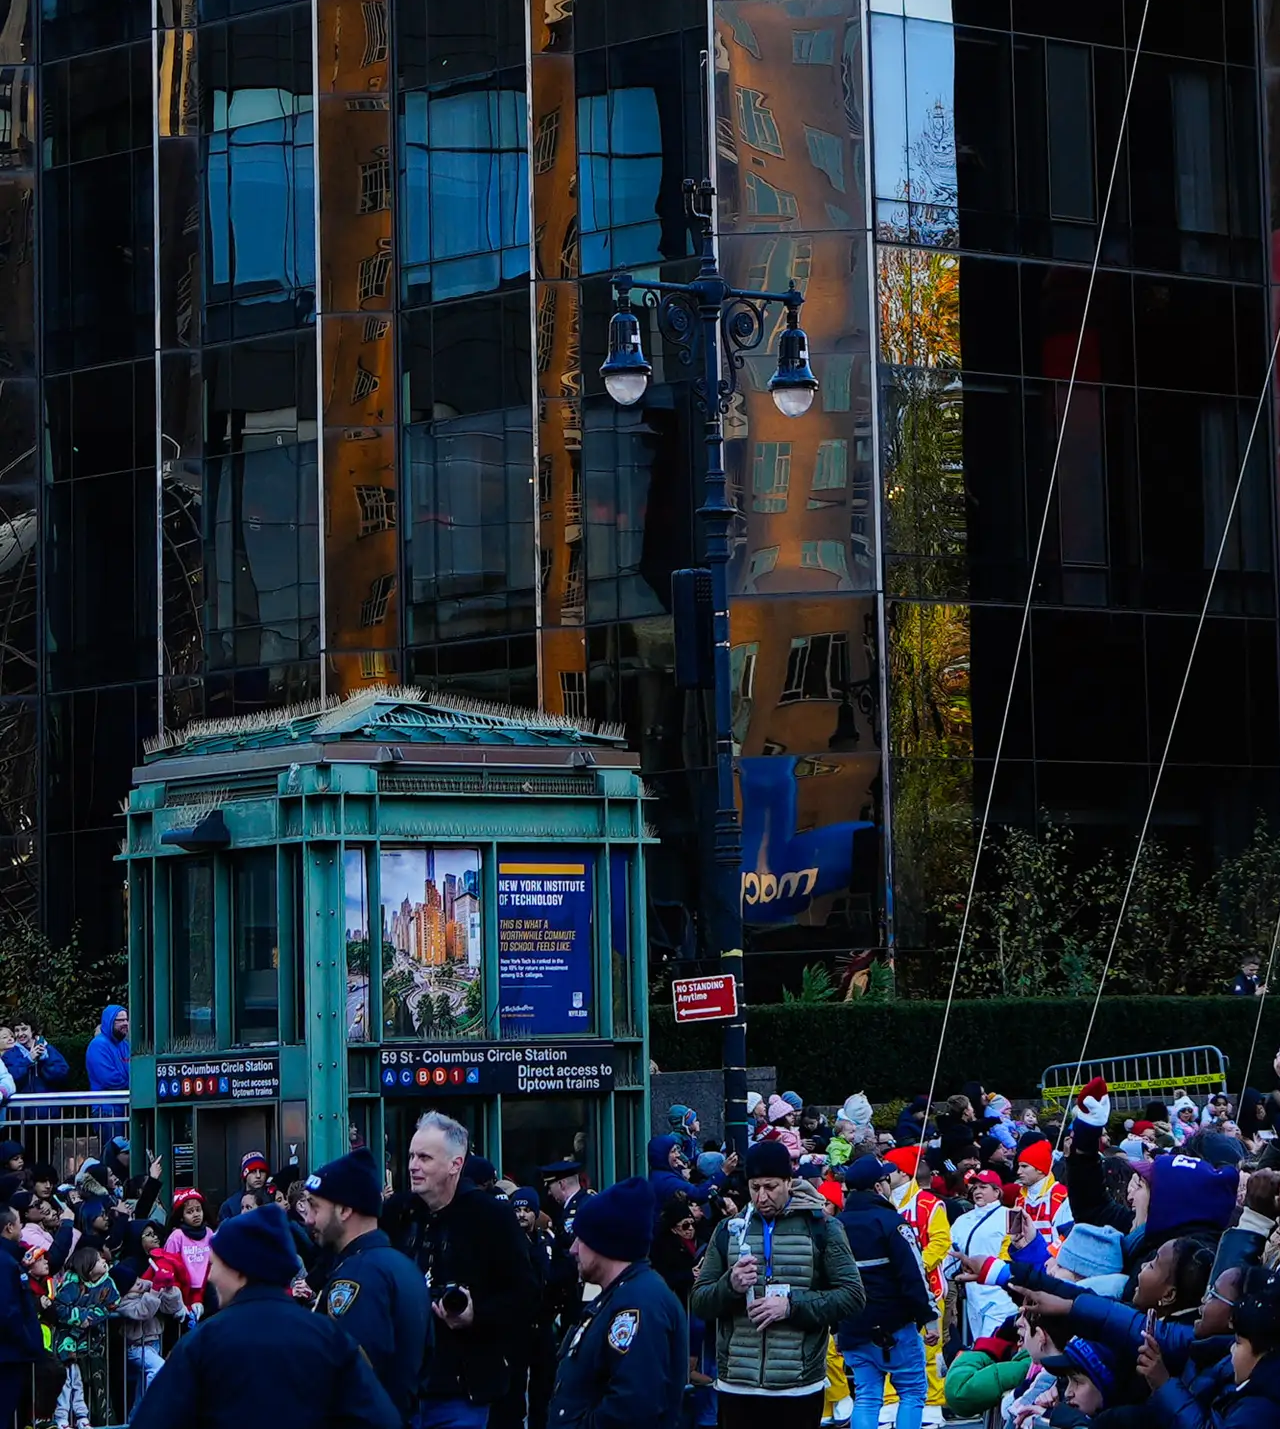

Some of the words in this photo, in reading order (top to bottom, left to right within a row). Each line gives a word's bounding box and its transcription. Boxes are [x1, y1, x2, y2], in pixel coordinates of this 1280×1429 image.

[499, 880, 518, 892] NEW
[520, 880, 542, 892] YORK
[544, 880, 585, 892] INSTITUTE
[499, 894, 509, 906] OF
[510, 894, 563, 906] TECHNOLOGY
[500, 919, 514, 929] THIS
[515, 919, 523, 929] IS
[524, 919, 543, 929] WHAT
[543, 919, 549, 929] A
[500, 931, 543, 940] WORTHWHILE
[544, 931, 576, 940] COMMUTE
[500, 942, 509, 951] TO
[509, 942, 535, 951] SCHOOL
[536, 942, 556, 951] FEELS
[676, 984, 687, 993] NO
[688, 980, 725, 992] STANDING
[678, 992, 708, 1003] Anytime
[381, 1052, 397, 1064] 59
[400, 1051, 413, 1063] St
[423, 1050, 485, 1063] Columbus
[487, 1049, 523, 1062] Circle
[525, 1048, 567, 1061] Station
[157, 1066, 167, 1077] 59
[168, 1066, 177, 1076] St
[181, 1063, 220, 1075] Columbus
[221, 1061, 244, 1073] Circle
[245, 1060, 273, 1072] Station
[518, 1064, 555, 1077] Direct
[556, 1066, 598, 1076] access
[600, 1064, 612, 1075] to
[232, 1079, 250, 1088] Direct
[518, 1078, 563, 1092] Uptown
[566, 1076, 600, 1089] trains
[1112, 1082, 1142, 1090] CAUTION
[1147, 1079, 1177, 1087] CAUTION
[1182, 1075, 1214, 1084] CAUTION
[232, 1088, 254, 1098] Uptown
[255, 1087, 273, 1095] trains
